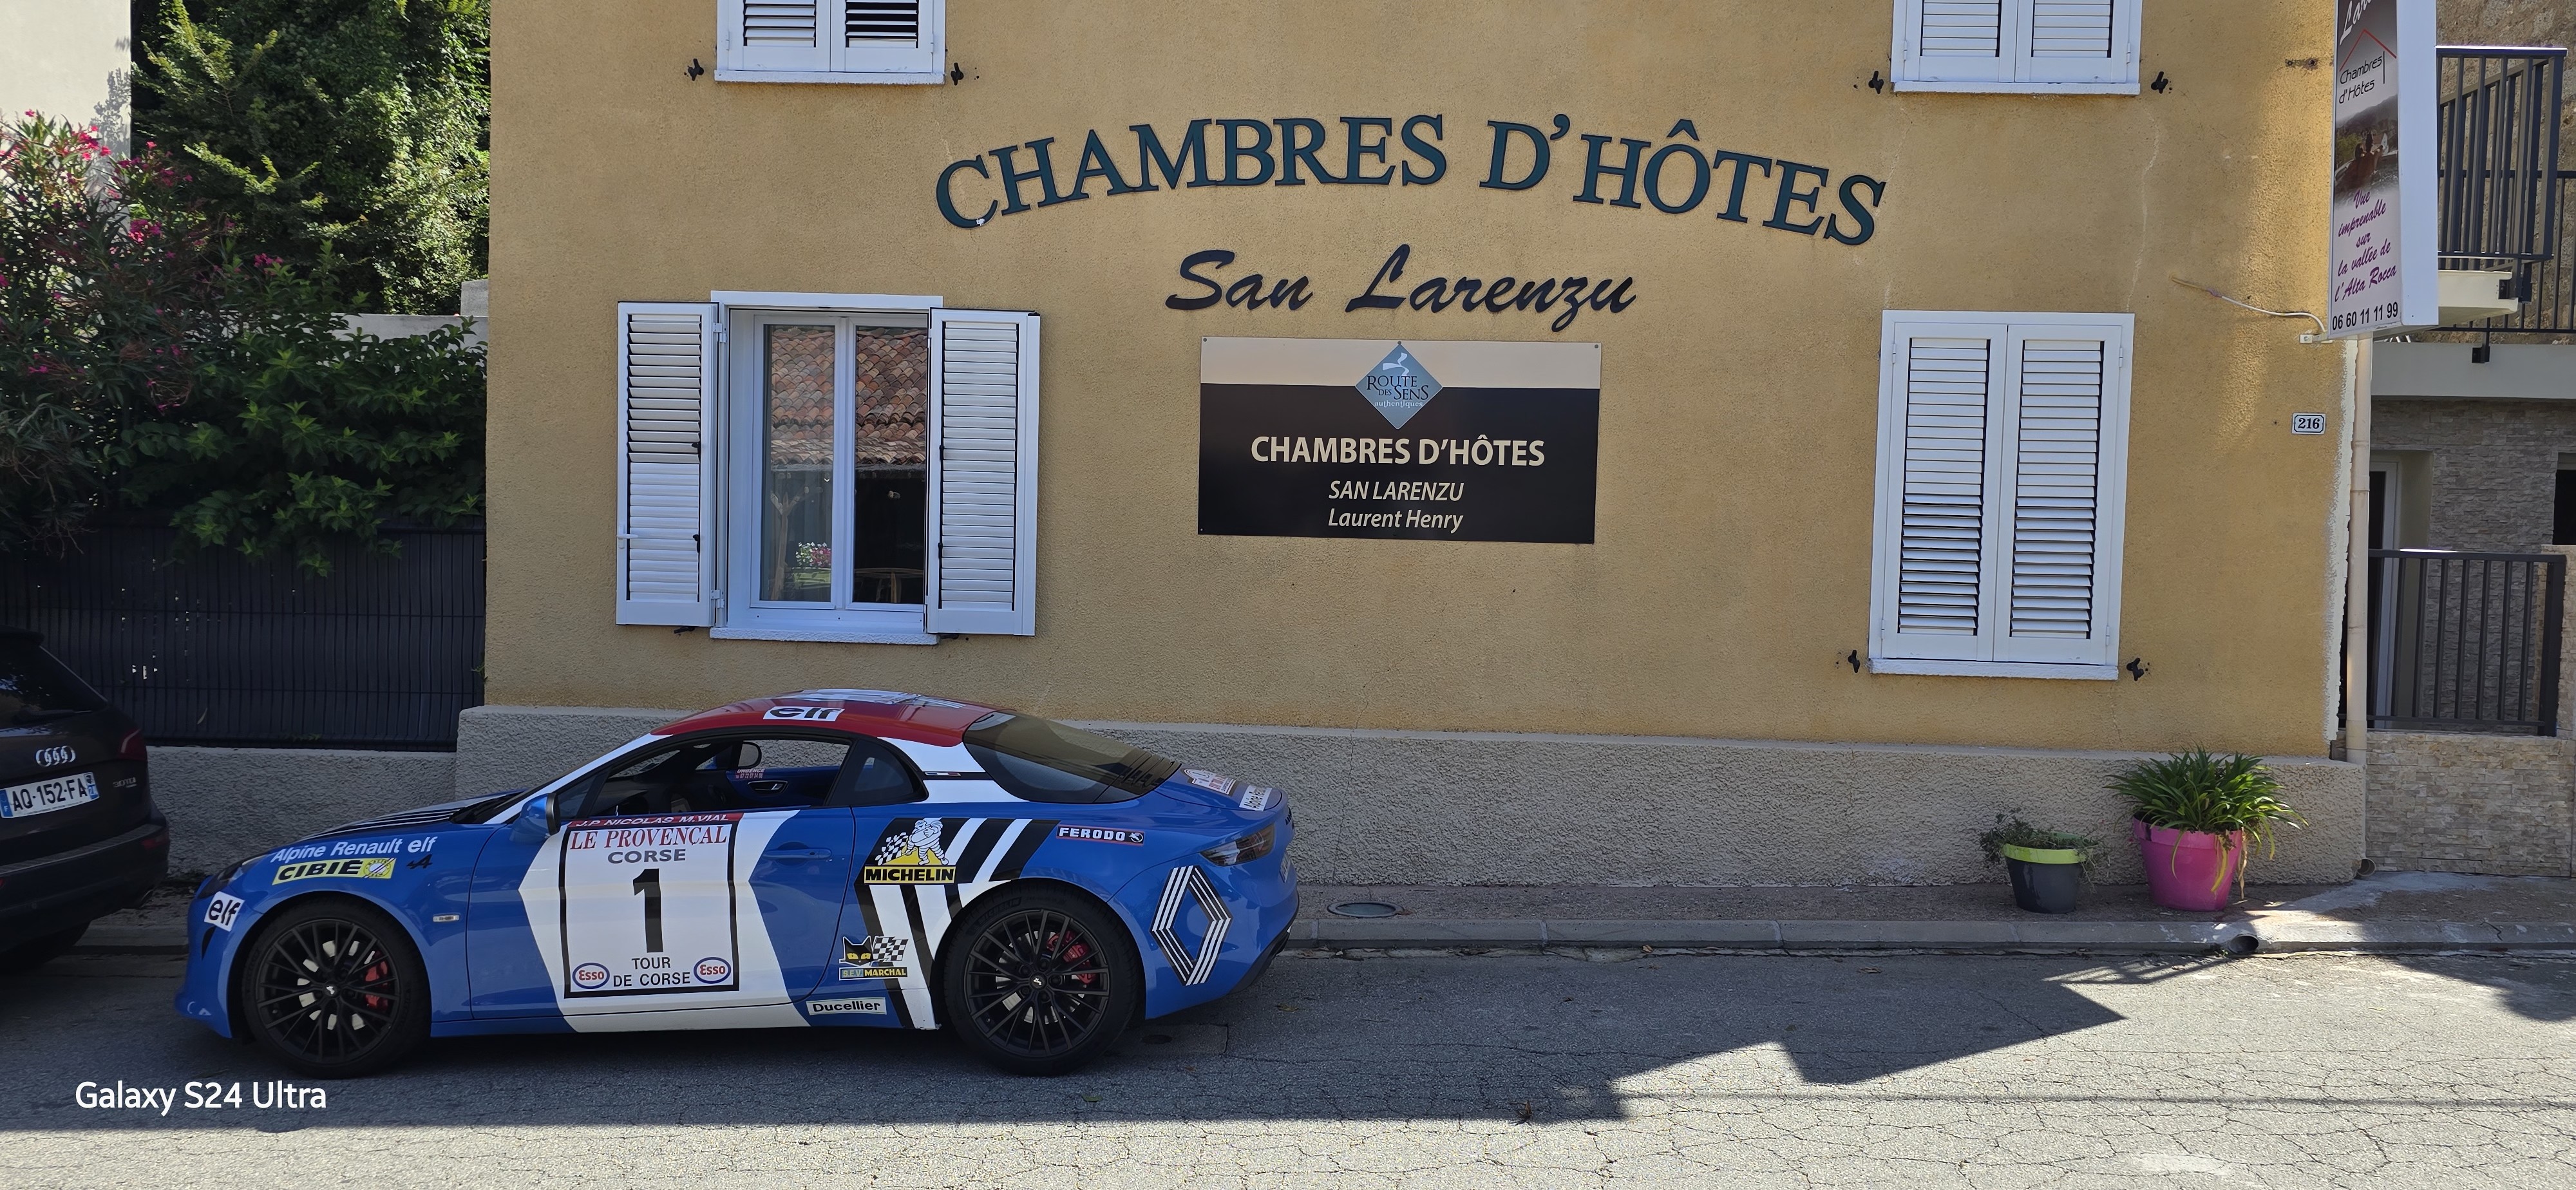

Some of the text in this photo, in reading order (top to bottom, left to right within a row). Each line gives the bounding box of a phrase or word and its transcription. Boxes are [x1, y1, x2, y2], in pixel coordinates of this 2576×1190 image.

[2340, 55, 2382, 84] Chambres
[2339, 79, 2374, 104] d'Hôtes
[936, 113, 1886, 246] CHAMBRES D'HÔTES
[2353, 189, 2371, 209] Vue
[2338, 199, 2386, 237] imprenable
[2356, 232, 2371, 248] sur
[2338, 260, 2348, 276] la
[2380, 238, 2391, 256] de
[1165, 244, 1636, 332] San Larenzu
[2334, 265, 2396, 302] l'Alta Rocca
[2332, 301, 2398, 330] 06 60 11 11 99
[1367, 375, 1417, 390] ROUTE
[1394, 385, 1428, 400] SENS
[2298, 418, 2320, 429] 216
[1251, 434, 1545, 466] CHAMBRES D'HÔTES
[1329, 480, 1464, 502] SAN LARENZU
[1328, 508, 1463, 533] Laurent Henry
[770, 708, 844, 719] elf
[603, 817, 674, 826] NICOLAS
[570, 826, 727, 850] LE PROVENÇAL
[1059, 827, 1126, 841] FERODO
[270, 836, 438, 864] Alpine Renault elf
[607, 849, 686, 864] CORSE
[866, 868, 954, 882] MICHELIN
[209, 900, 240, 926] elf
[633, 868, 663, 953] 1
[632, 957, 670, 970] TOUR
[613, 972, 690, 987] DE CORSE
[813, 1001, 880, 1012] Ducellier
